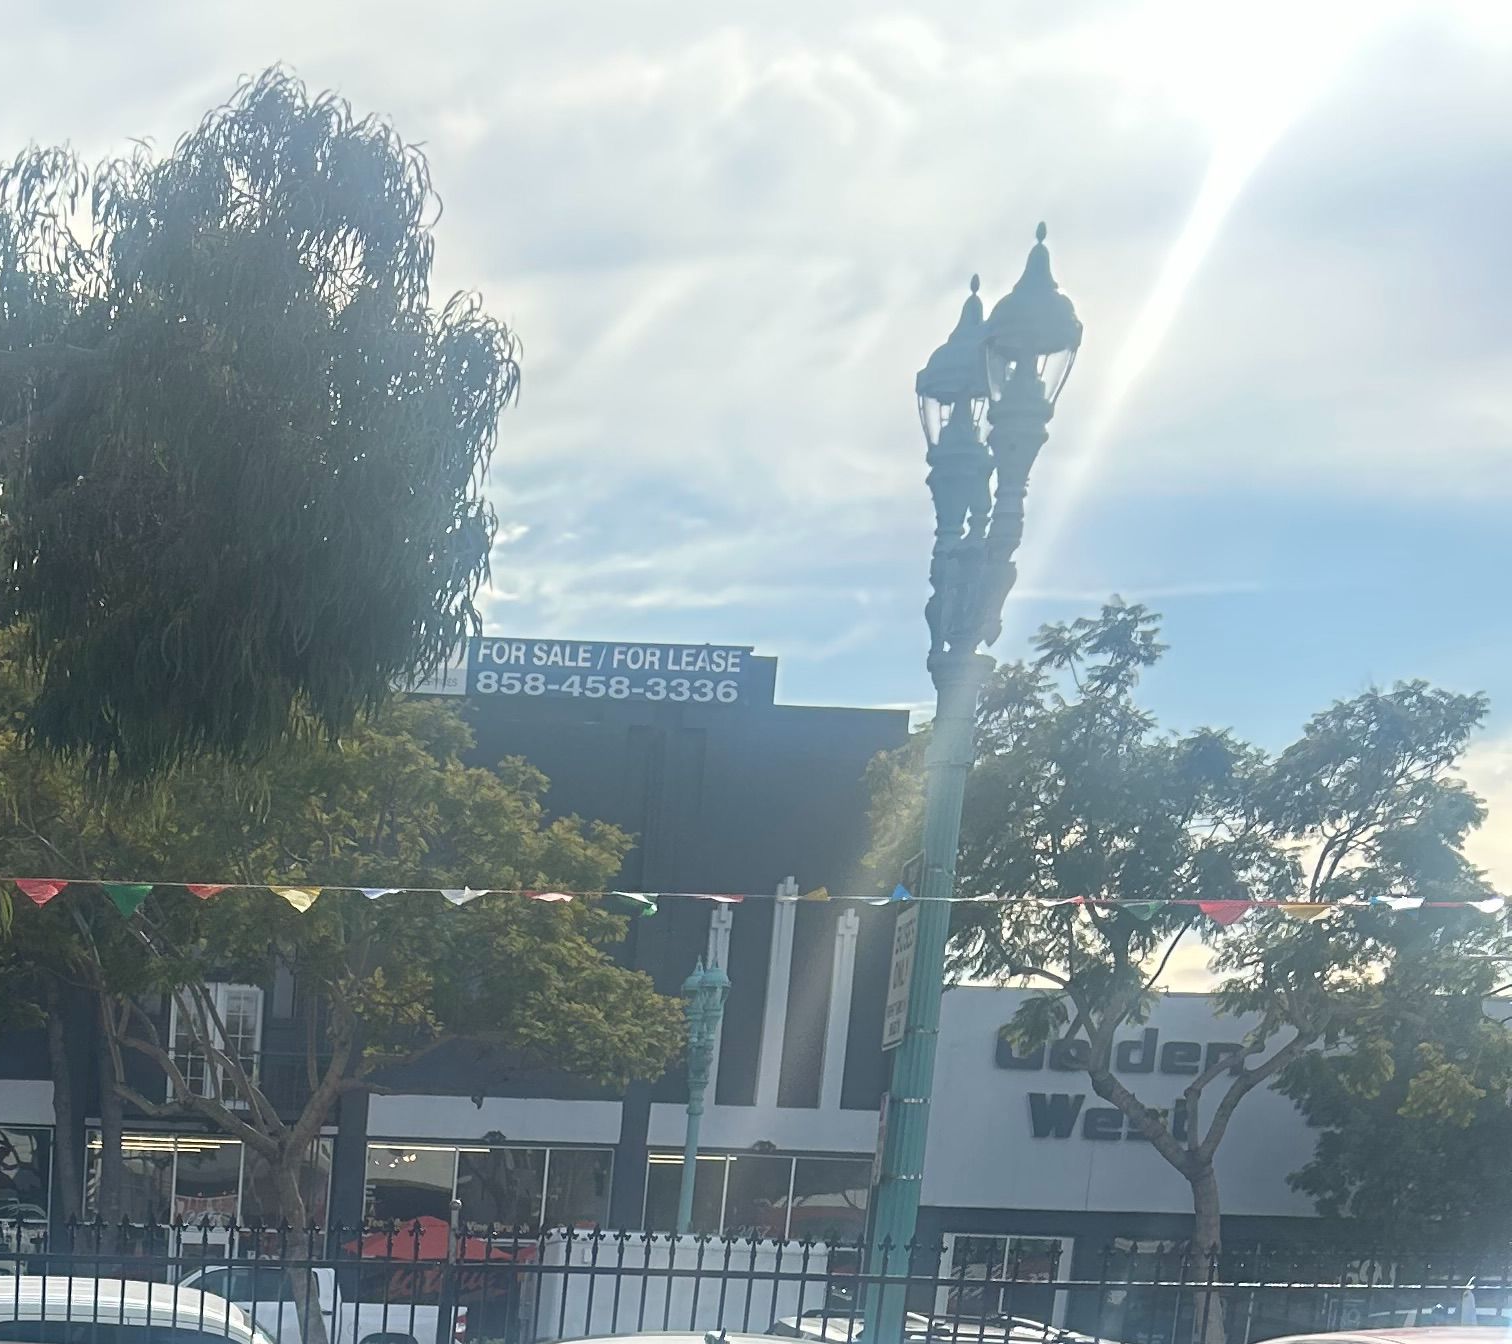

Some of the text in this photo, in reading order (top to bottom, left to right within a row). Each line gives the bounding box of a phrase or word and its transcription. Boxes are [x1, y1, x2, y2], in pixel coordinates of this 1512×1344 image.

[477, 641, 742, 674] FOR SALE / FOR LEASE
[476, 671, 739, 703] 858-458-3336
